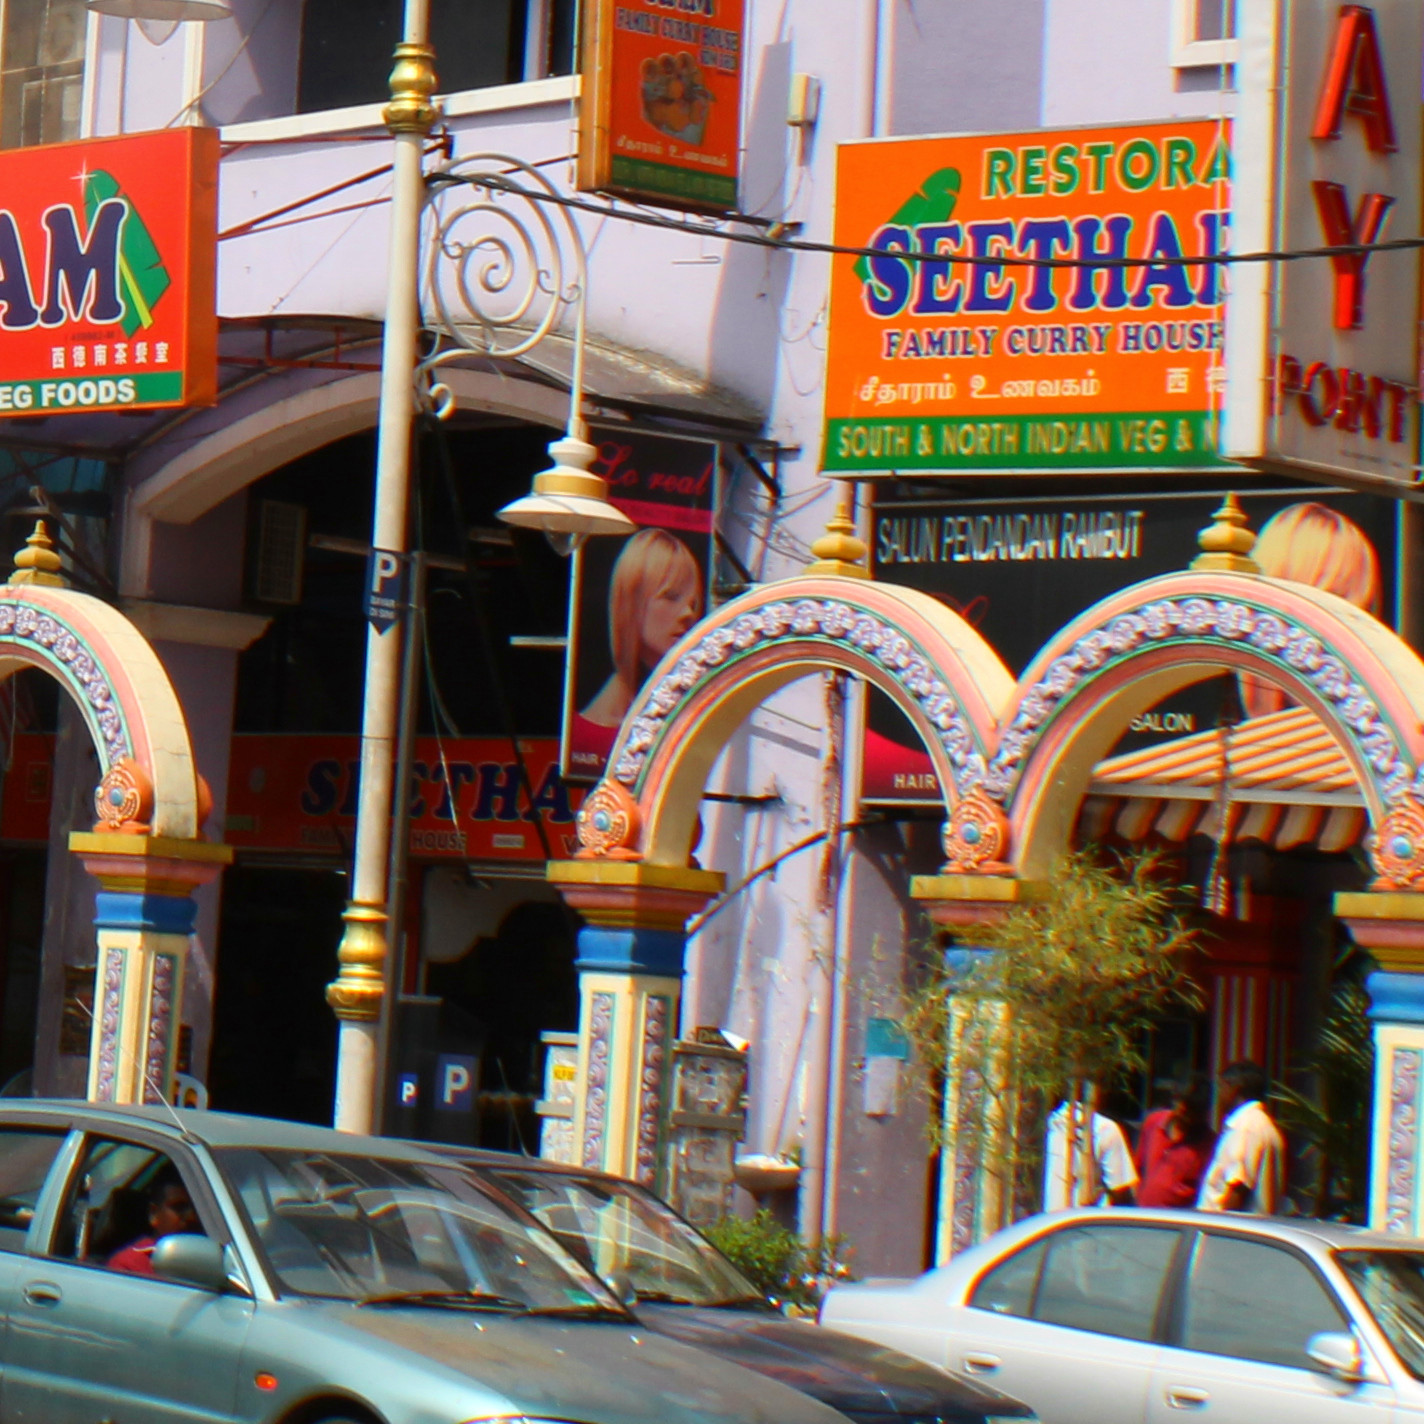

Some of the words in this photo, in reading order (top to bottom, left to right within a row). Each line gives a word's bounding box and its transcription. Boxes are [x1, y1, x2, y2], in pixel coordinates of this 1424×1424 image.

[882, 326, 998, 359] FAMILY
[1006, 324, 1112, 356] CURRY
[40, 377, 136, 407] FOODS
[838, 424, 910, 458] SOUTH
[917, 425, 934, 455] &
[941, 422, 1021, 456] NORTH
[1026, 421, 1110, 455] INDIAN
[1118, 420, 1168, 453] VEG
[1175, 419, 1194, 452] &
[372, 552, 399, 593] P
[1131, 712, 1193, 733] SALON
[893, 772, 936, 790] HAIR
[443, 1065, 469, 1103] P
